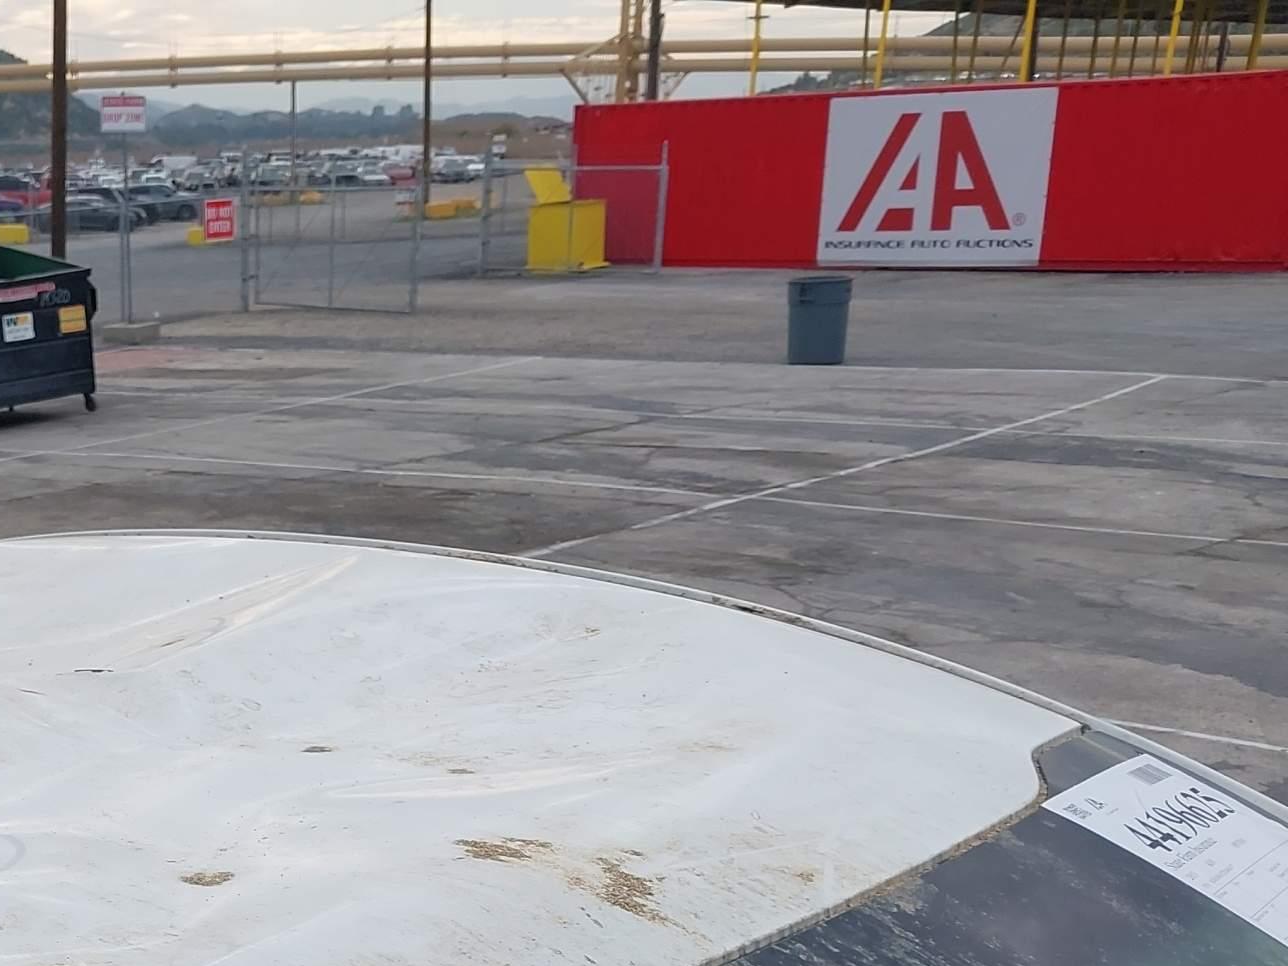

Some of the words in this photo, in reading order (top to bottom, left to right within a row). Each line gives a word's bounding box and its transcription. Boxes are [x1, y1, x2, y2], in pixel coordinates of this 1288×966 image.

[824, 240, 905, 250] INSURANCE
[911, 240, 952, 249] AUTO
[955, 238, 1034, 249] AUCTIONS
[1124, 787, 1235, 851] 44196625
